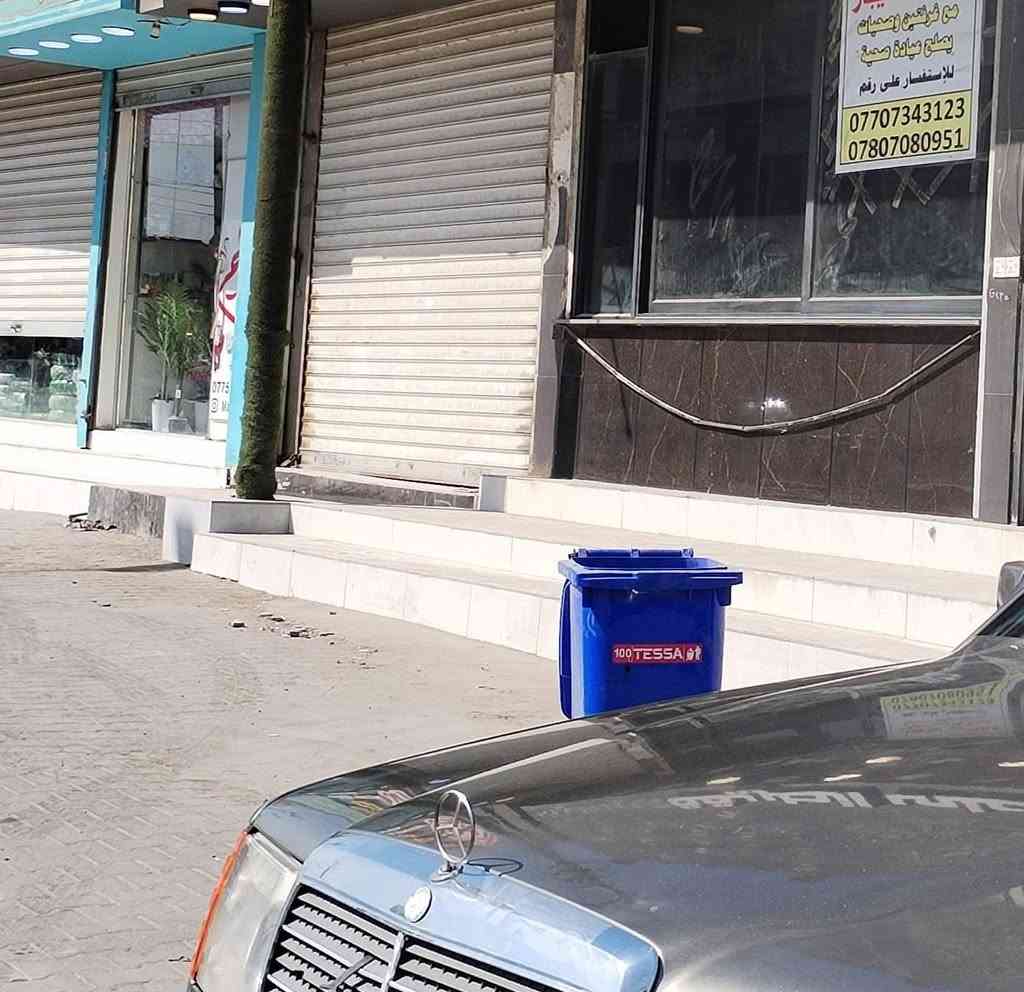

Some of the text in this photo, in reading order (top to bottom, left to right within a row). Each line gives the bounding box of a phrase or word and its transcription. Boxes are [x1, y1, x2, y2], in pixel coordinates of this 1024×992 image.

[857, 14, 901, 37] وصحيات
[901, 3, 940, 31] غرفتين
[942, 3, 959, 24] مع
[860, 32, 954, 67] يصلح عيادة صحية
[859, 77, 876, 96] رقم
[880, 74, 900, 92] على
[849, 97, 965, 133] 07707343123
[848, 128, 964, 161] 07807080951
